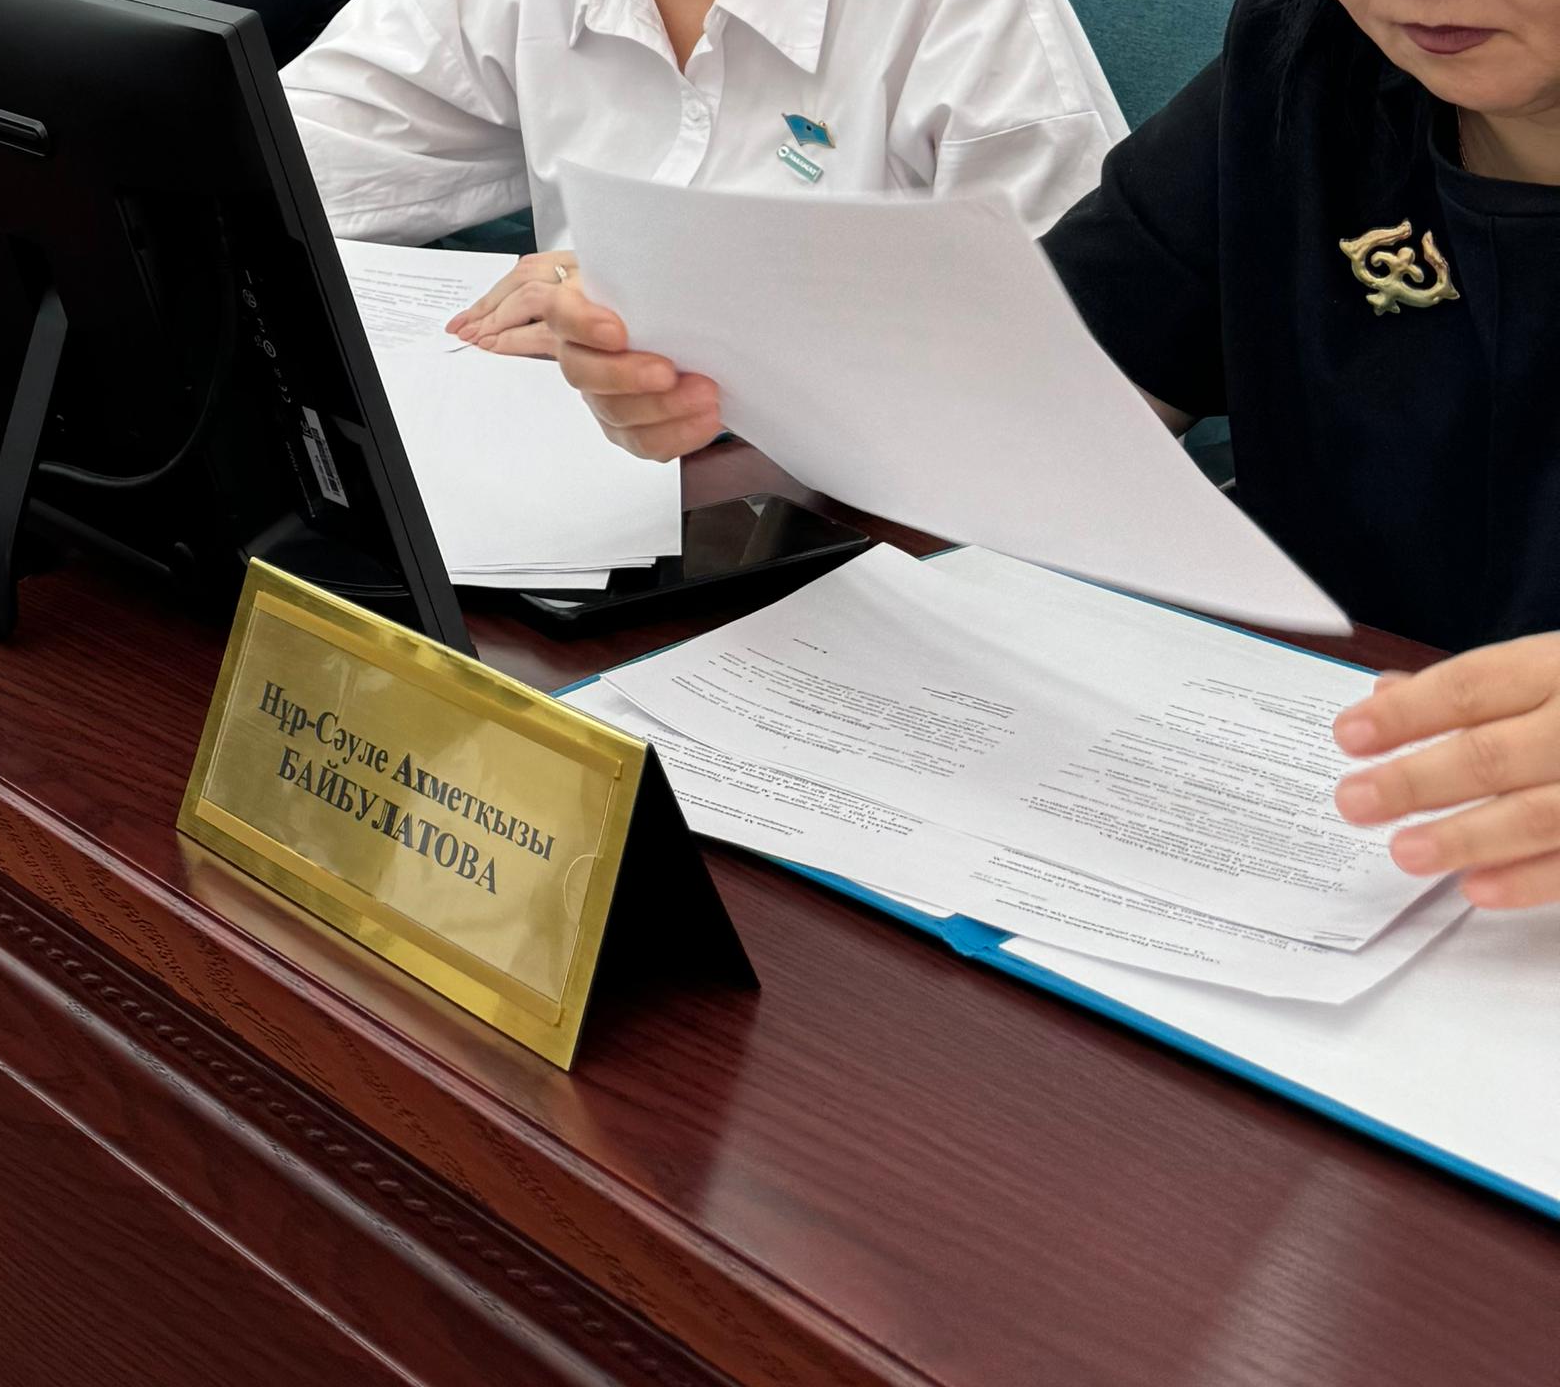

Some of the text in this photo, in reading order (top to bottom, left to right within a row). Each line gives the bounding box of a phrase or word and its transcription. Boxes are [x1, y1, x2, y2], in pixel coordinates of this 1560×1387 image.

[258, 680, 389, 774] Нұр-Сәуле
[391, 752, 556, 862] Ахметқызы
[276, 745, 497, 895] БАЙБУЛАТОВА
